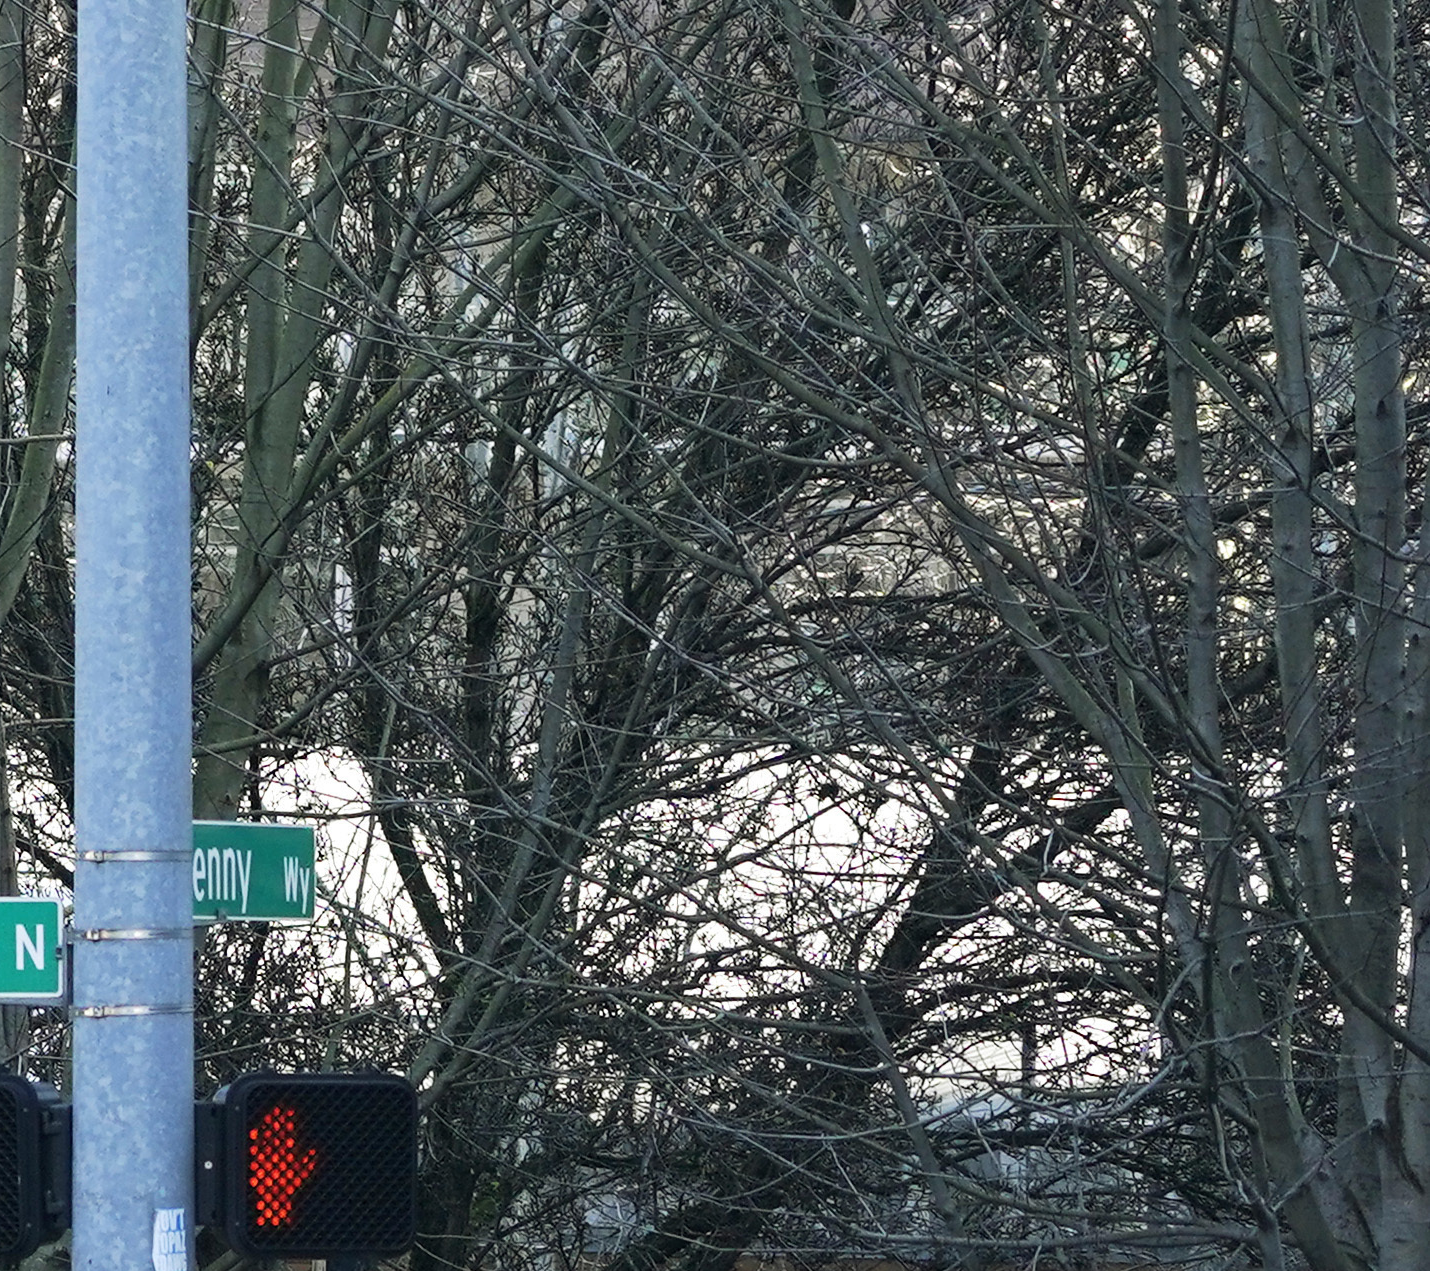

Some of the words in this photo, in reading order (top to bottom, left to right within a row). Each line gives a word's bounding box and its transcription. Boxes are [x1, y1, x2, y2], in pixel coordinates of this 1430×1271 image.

[192, 847, 252, 915] enny
[283, 856, 310, 915] Wy
[15, 924, 45, 971] N
